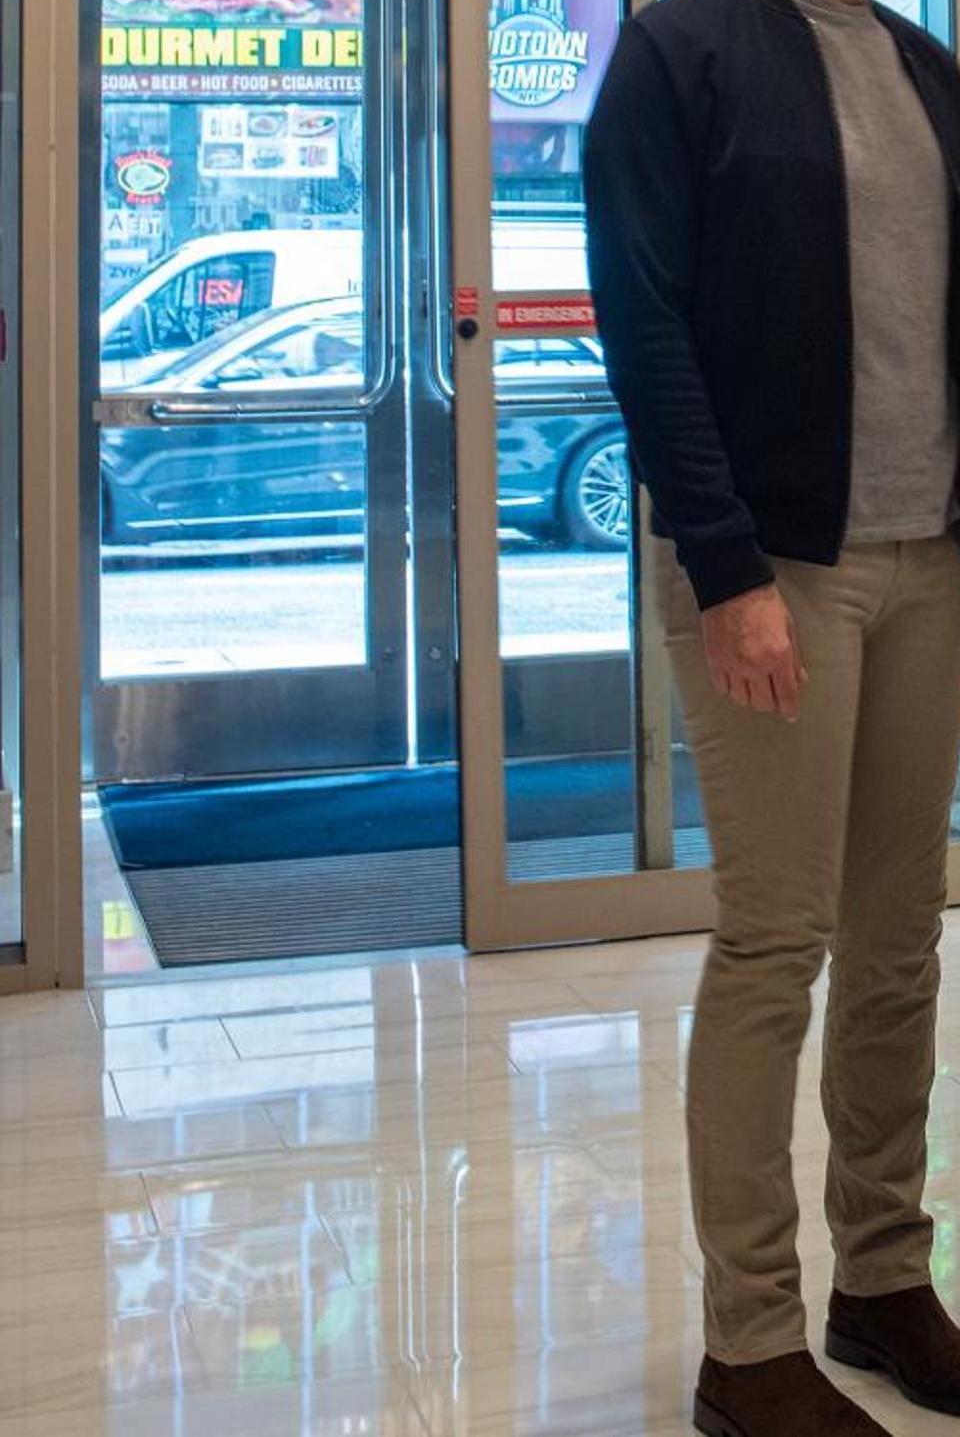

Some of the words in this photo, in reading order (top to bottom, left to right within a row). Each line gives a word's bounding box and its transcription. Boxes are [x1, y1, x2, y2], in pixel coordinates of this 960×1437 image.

[101, 28, 286, 66] OURMET
[302, 29, 363, 67] DE
[101, 74, 138, 90] SODA
[151, 75, 187, 90] BEER
[201, 75, 228, 90] HOT
[232, 76, 269, 91] FOOD
[282, 75, 363, 92] CIGARETTES
